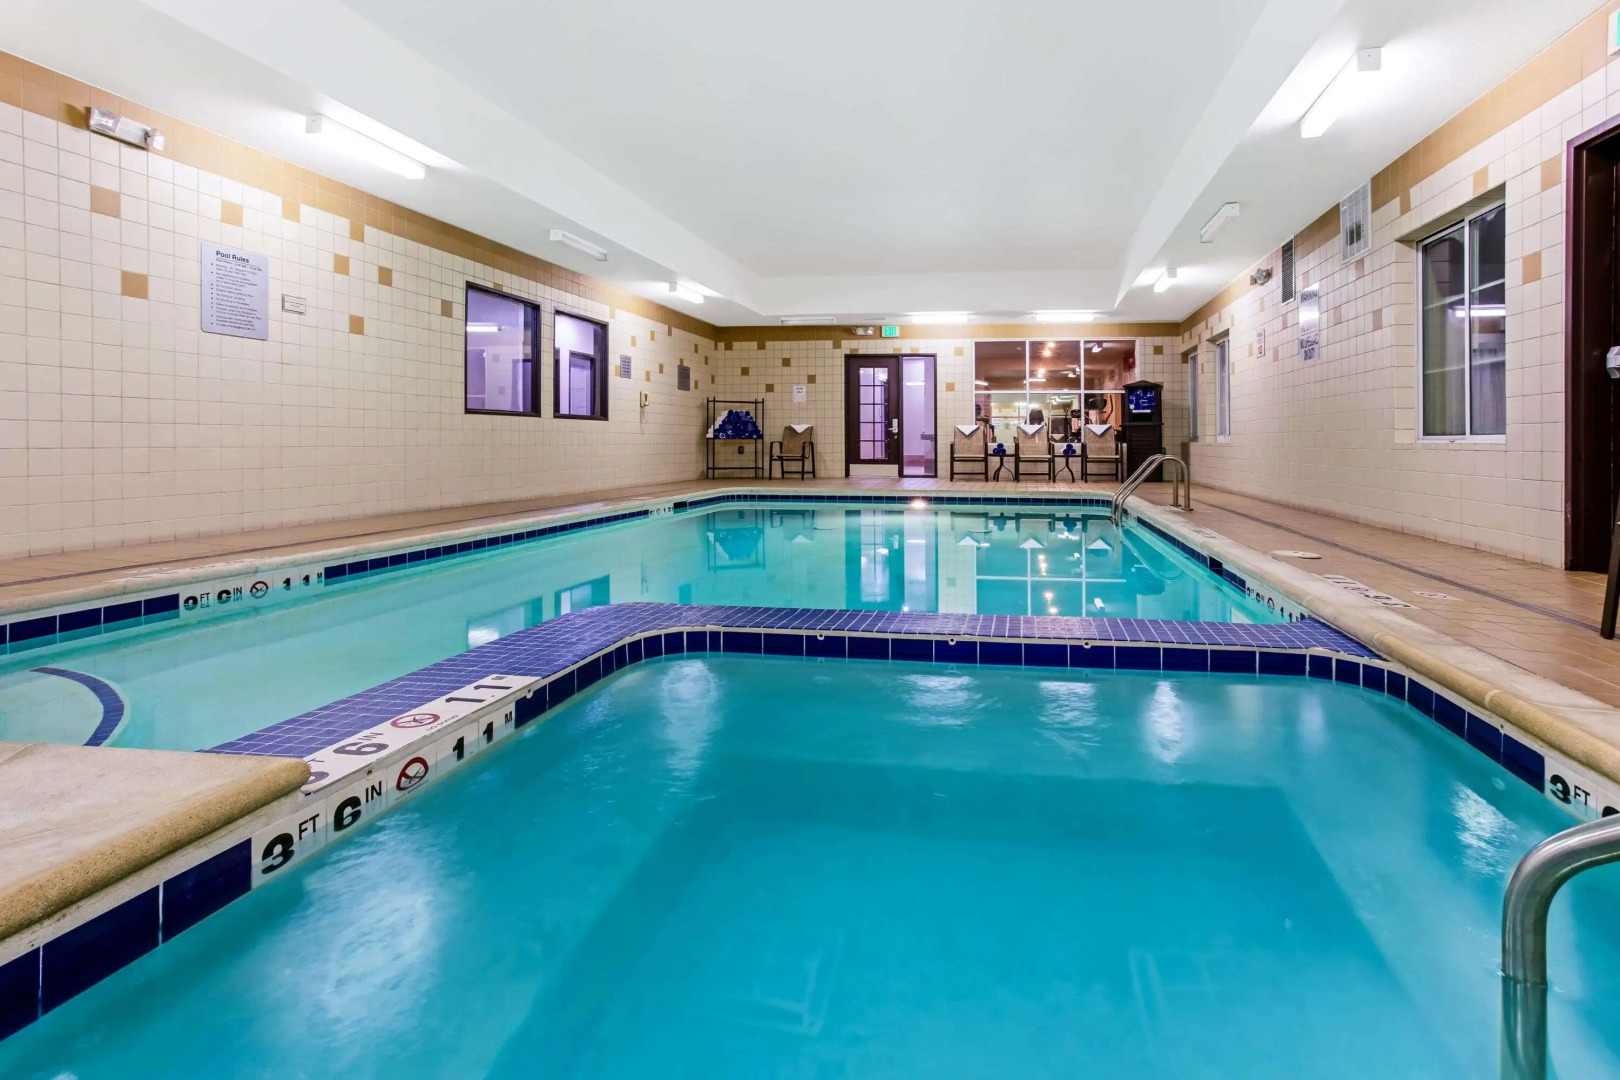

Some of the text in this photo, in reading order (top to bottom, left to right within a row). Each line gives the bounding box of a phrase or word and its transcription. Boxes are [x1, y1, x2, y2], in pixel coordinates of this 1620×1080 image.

[216, 251, 250, 263] Pool Rules
[333, 741, 390, 756] 6
[261, 832, 295, 875] 3
[299, 813, 320, 841] FT
[333, 795, 362, 832] 6
[366, 780, 383, 803] IN
[504, 710, 513, 725] M
[1549, 773, 1591, 806] 3 FT
